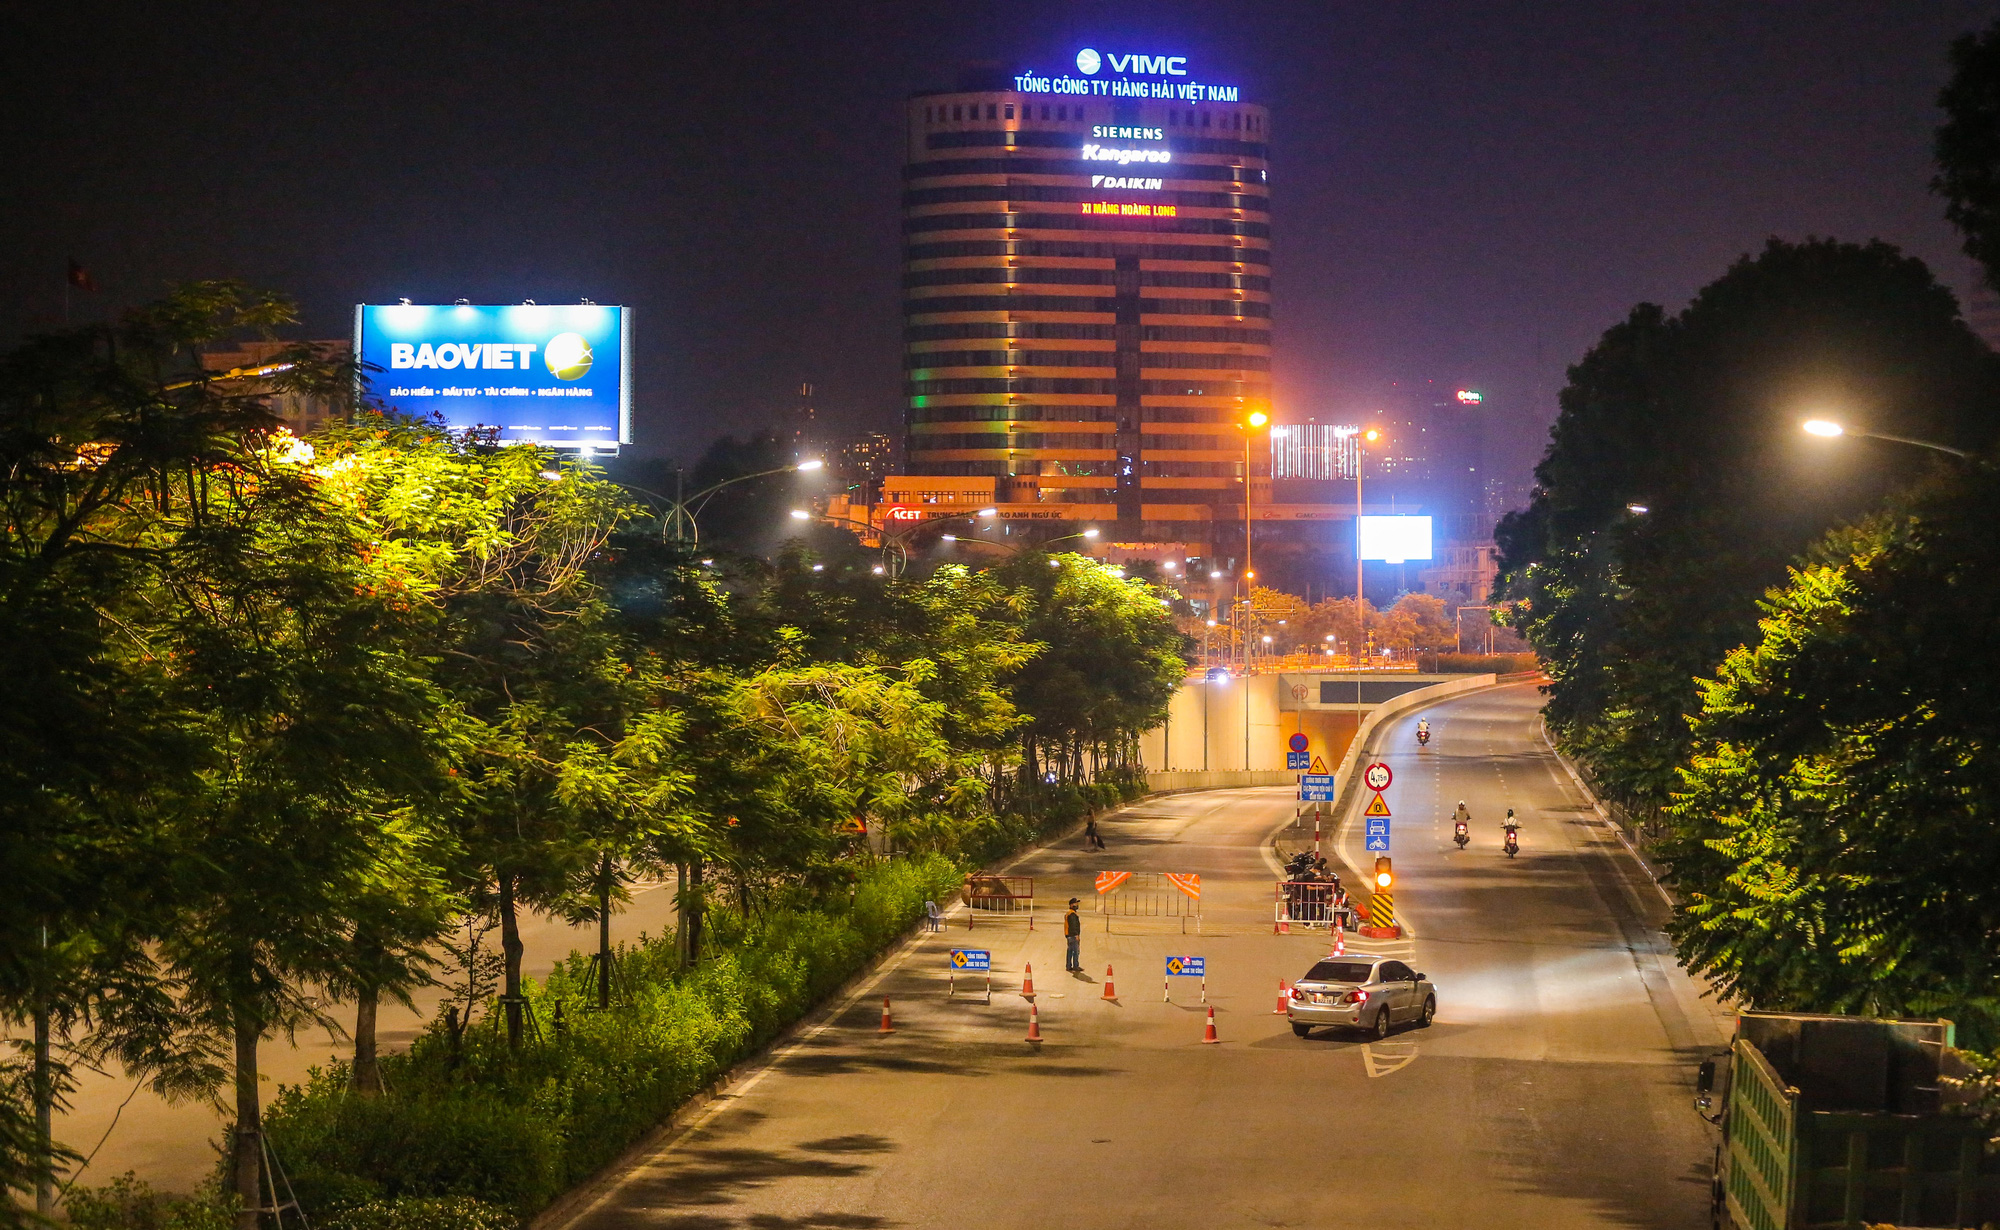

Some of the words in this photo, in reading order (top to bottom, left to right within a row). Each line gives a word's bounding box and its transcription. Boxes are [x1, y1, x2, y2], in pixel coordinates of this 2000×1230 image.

[1014, 70, 1051, 93] TỔNG
[1052, 75, 1089, 95] CÔNG
[1091, 80, 1109, 96] TY
[1112, 77, 1149, 98] HÀNG
[1151, 79, 1174, 99] HẢI
[1177, 81, 1206, 105] VIỆT
[1208, 85, 1238, 102] NAM
[1092, 125, 1163, 140] SIEMENS
[1082, 144, 1171, 165] Kangaroo
[1103, 176, 1163, 190] DAIKIN
[1082, 203, 1092, 214] XI
[1093, 201, 1120, 215] MĂNG
[1121, 203, 1151, 216] HOÀNG
[1153, 205, 1176, 217] LONG
[390, 343, 537, 370] BAOVIET
[894, 510, 921, 520] ACET
